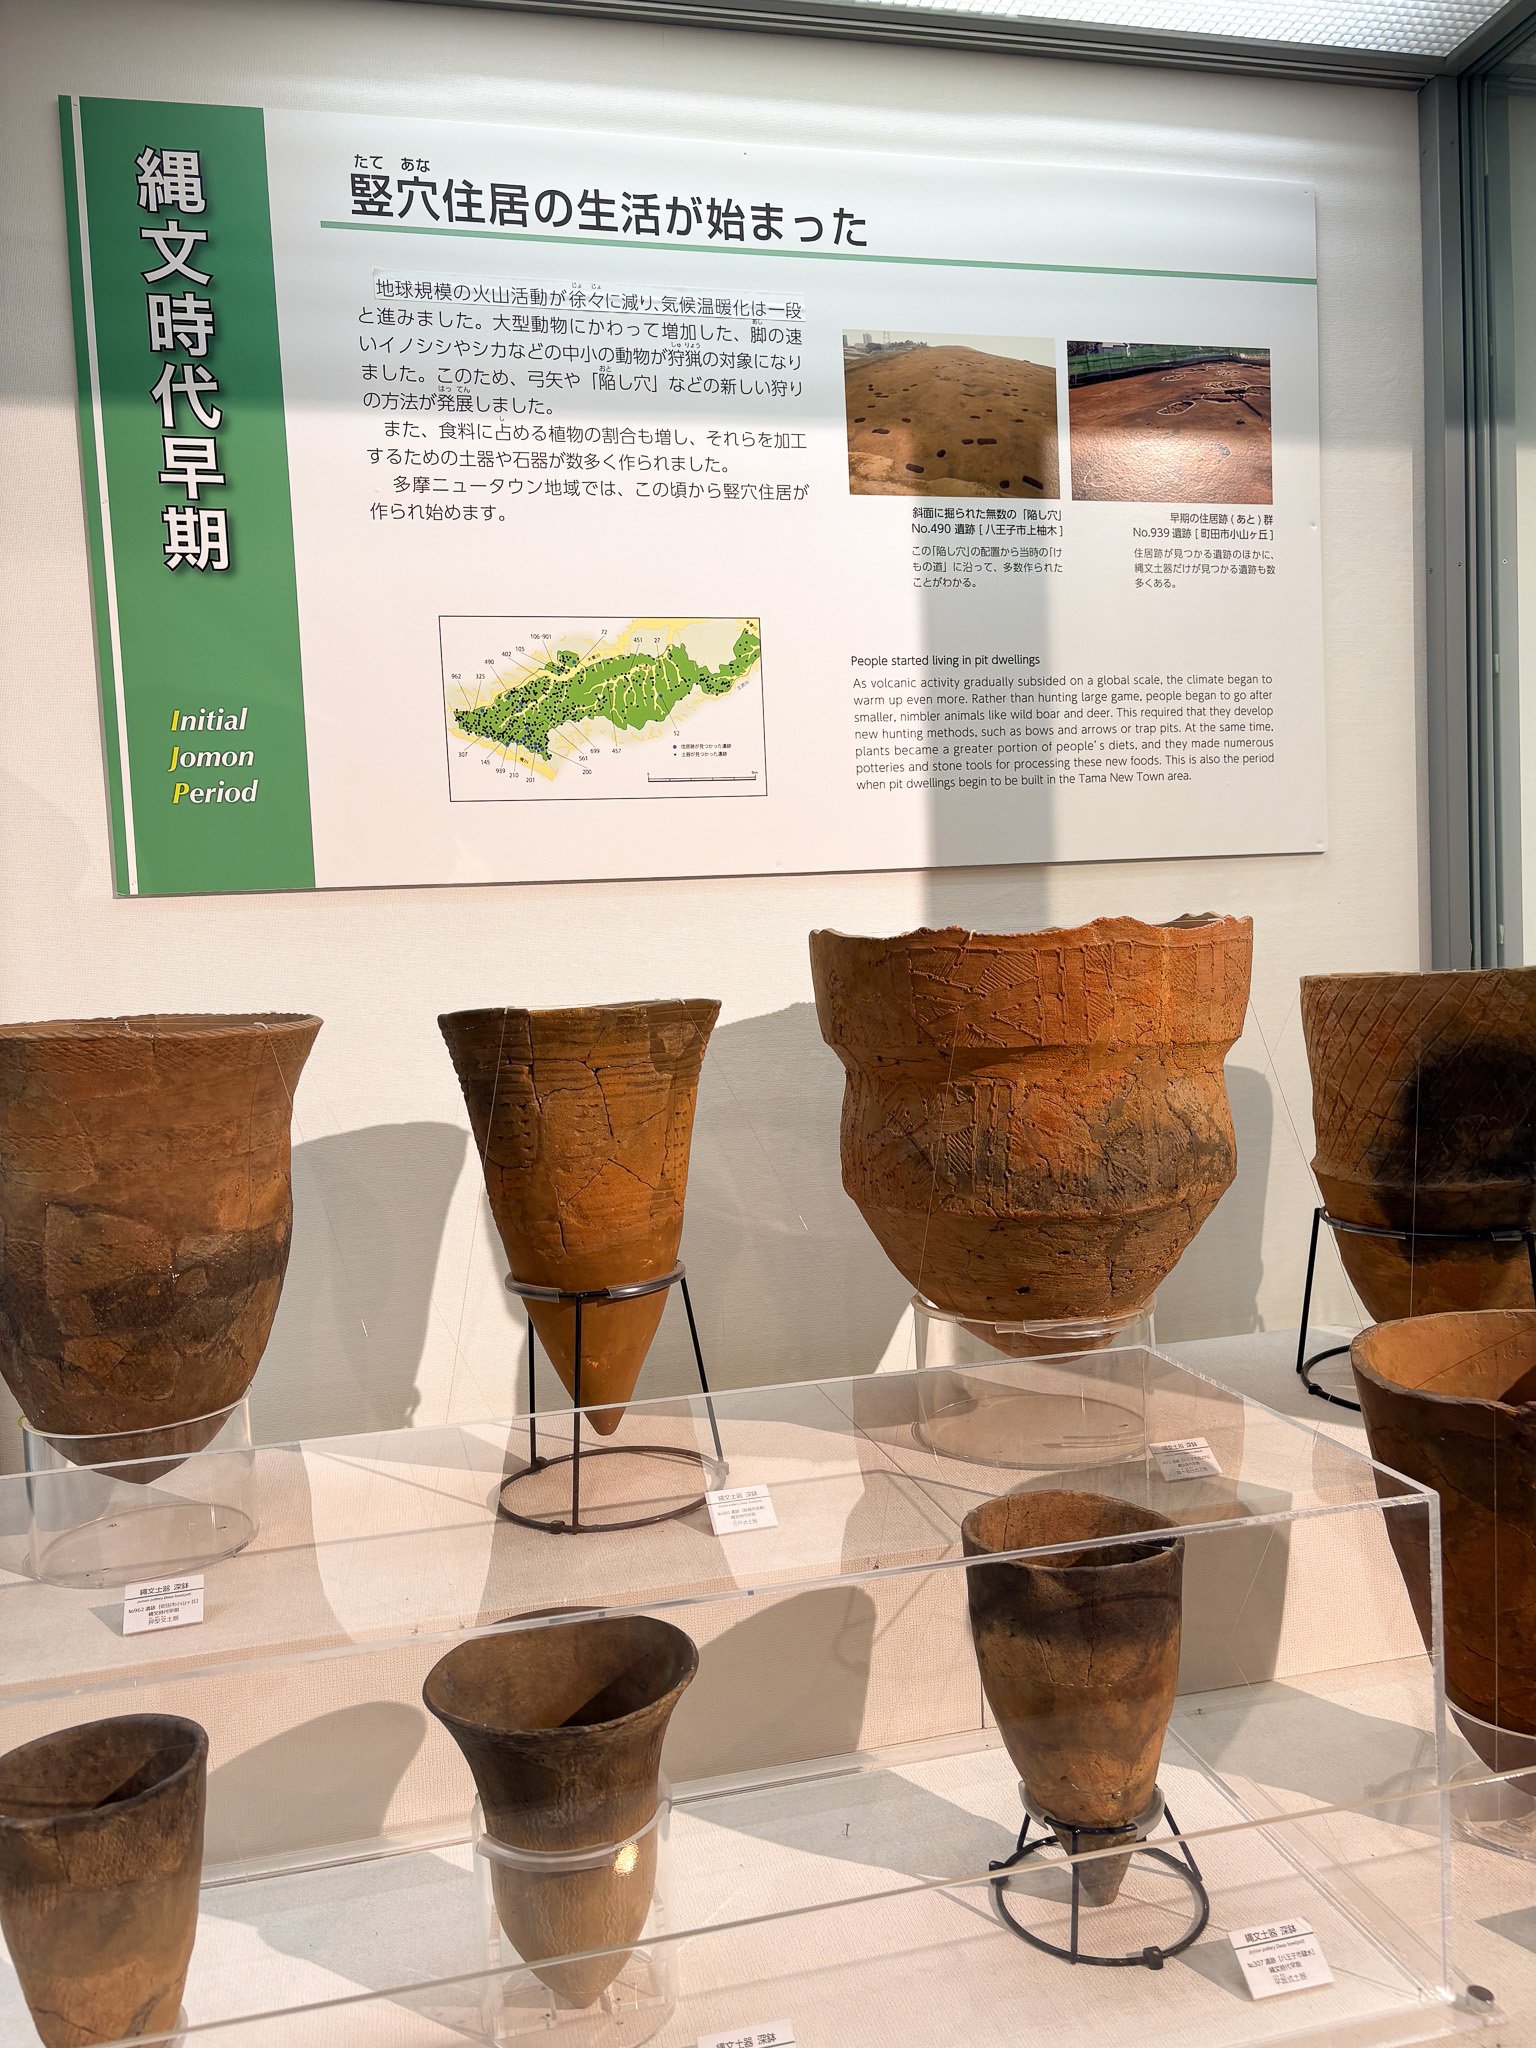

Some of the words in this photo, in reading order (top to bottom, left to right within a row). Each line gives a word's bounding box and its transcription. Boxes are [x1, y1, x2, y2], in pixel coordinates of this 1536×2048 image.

[353, 153, 384, 169] たて
[401, 157, 431, 173] あな
[350, 172, 868, 247] 竪穴住居の生活が始まった
[376, 279, 802, 320] 地球規模の火山活動が徐々に減り、気候温暖化は一段
[358, 307, 803, 346] と進みました。大型動物にかわって増加した、脚の速
[137, 147, 230, 573] 縄文時代早期
[359, 336, 801, 370] いイノシシやシカなどの中小の動物が狩猟の対象になり
[361, 364, 802, 397] ました。このため、弓矢や「陥し穴」などの新しい狩り
[363, 392, 554, 415] の方法が発展しました。
[384, 420, 807, 449] また、食料に占める植物の割合も増し、それらを加工
[366, 448, 729, 473] するための土器や石器が数多く作られました。
[393, 475, 810, 501] 多摩ニュータウン地域では、この頃から竪穴住居が
[370, 501, 506, 522] 作られ始めます。
[912, 507, 1062, 521] 斜面に掘られた無数の「陥し穴」
[911, 523, 951, 534] No.490
[954, 523, 976, 535] 遺跡
[1132, 527, 1170, 538] No.939
[1172, 528, 1191, 539] 遺跡
[1134, 547, 1275, 560] 住居跡が見つかる遺跡のほかに、
[912, 561, 1063, 573] もの道」に沿って、多数作られた
[1134, 563, 1275, 575] 縄文土器だけが見つかる遺跡も数
[913, 577, 977, 588] ことがわかる。
[1134, 577, 1177, 589] 多くある。
[851, 655, 888, 668] People
[891, 655, 928, 666] started
[932, 654, 959, 668] living
[962, 655, 971, 665] in
[974, 654, 988, 668] pit
[991, 654, 1040, 667] dwellings
[852, 678, 866, 688] As
[870, 677, 916, 688] volcanic
[920, 677, 960, 690] activity
[963, 676, 1013, 690] gradually
[1017, 675, 1066, 686] subsided
[1069, 677, 1083, 685] on
[1097, 674, 1129, 687] global
[1166, 674, 1183, 684] the
[1186, 674, 1224, 685] climate
[1227, 674, 1258, 687] began
[1261, 674, 1272, 684] to
[853, 696, 885, 705] warm
[888, 696, 902, 707] up
[906, 696, 933, 704] even
[936, 695, 968, 704] more.
[971, 693, 1007, 703] Rather
[1010, 692, 1034, 703] than
[1038, 692, 1077, 705] hunting
[1081, 691, 1107, 704] large
[1145, 690, 1181, 703] people
[1185, 690, 1216, 703] began
[1219, 690, 1230, 700] to
[1233, 691, 1246, 702] go
[1249, 689, 1272, 700] after
[170, 707, 248, 734] Initial
[900, 711, 940, 722] nimbler
[944, 710, 985, 721] animals
[988, 709, 1006, 719] like
[1010, 709, 1032, 720] wild
[1035, 708, 1059, 719] boar
[1063, 708, 1083, 719] and
[1086, 707, 1112, 718] deer.
[1116, 707, 1137, 717] This
[1140, 706, 1183, 719] required
[1186, 706, 1206, 716] that
[1209, 705, 1230, 719] they
[1233, 705, 1273, 718] develop
[854, 731, 878, 739] new
[882, 728, 923, 741] hunting
[981, 725, 1006, 737] such
[1009, 728, 1021, 736] as
[1025, 725, 1054, 736] bows
[1057, 725, 1077, 735] and
[1081, 726, 1117, 734] arrows
[1120, 725, 1131, 733] or
[1135, 724, 1156, 735] trap
[1159, 722, 1181, 735] pits.
[1184, 722, 1196, 732] At
[1199, 722, 1215, 732] the
[1219, 723, 1245, 732] same
[168, 745, 255, 773] Jomon
[855, 746, 890, 759] plants
[894, 744, 939, 755] became
[953, 743, 994, 756] greater
[997, 742, 1037, 755] portion
[1040, 741, 1052, 752] of
[1141, 739, 1160, 749] and
[1164, 738, 1187, 751] they
[1191, 738, 1220, 749] made
[1223, 739, 1273, 748] numerous
[856, 762, 904, 775] potteries
[908, 761, 928, 771] and
[932, 761, 962, 771] stone
[965, 759, 992, 770] tools
[995, 758, 1010, 769] for
[1013, 758, 1070, 772] processing
[1073, 756, 1102, 767] these
[1105, 758, 1127, 766] new
[1130, 754, 1161, 766] foods.
[1165, 754, 1185, 765] This
[1188, 755, 1196, 765] is
[1199, 754, 1220, 764] also
[1223, 753, 1239, 763] the
[1242, 753, 1274, 765] period
[856, 779, 885, 790] when
[889, 779, 902, 791] pit
[906, 777, 955, 791] dwellings
[958, 776, 987, 790] begin
[990, 776, 1001, 786] to
[1004, 775, 1017, 786] be
[1021, 774, 1043, 785] built
[1046, 774, 1055, 784] in
[1058, 774, 1075, 784] the
[1078, 772, 1106, 783] Tama
[1109, 772, 1133, 783] New
[1136, 771, 1164, 781] Town
[1167, 772, 1191, 781] area.
[171, 779, 259, 808] Period
